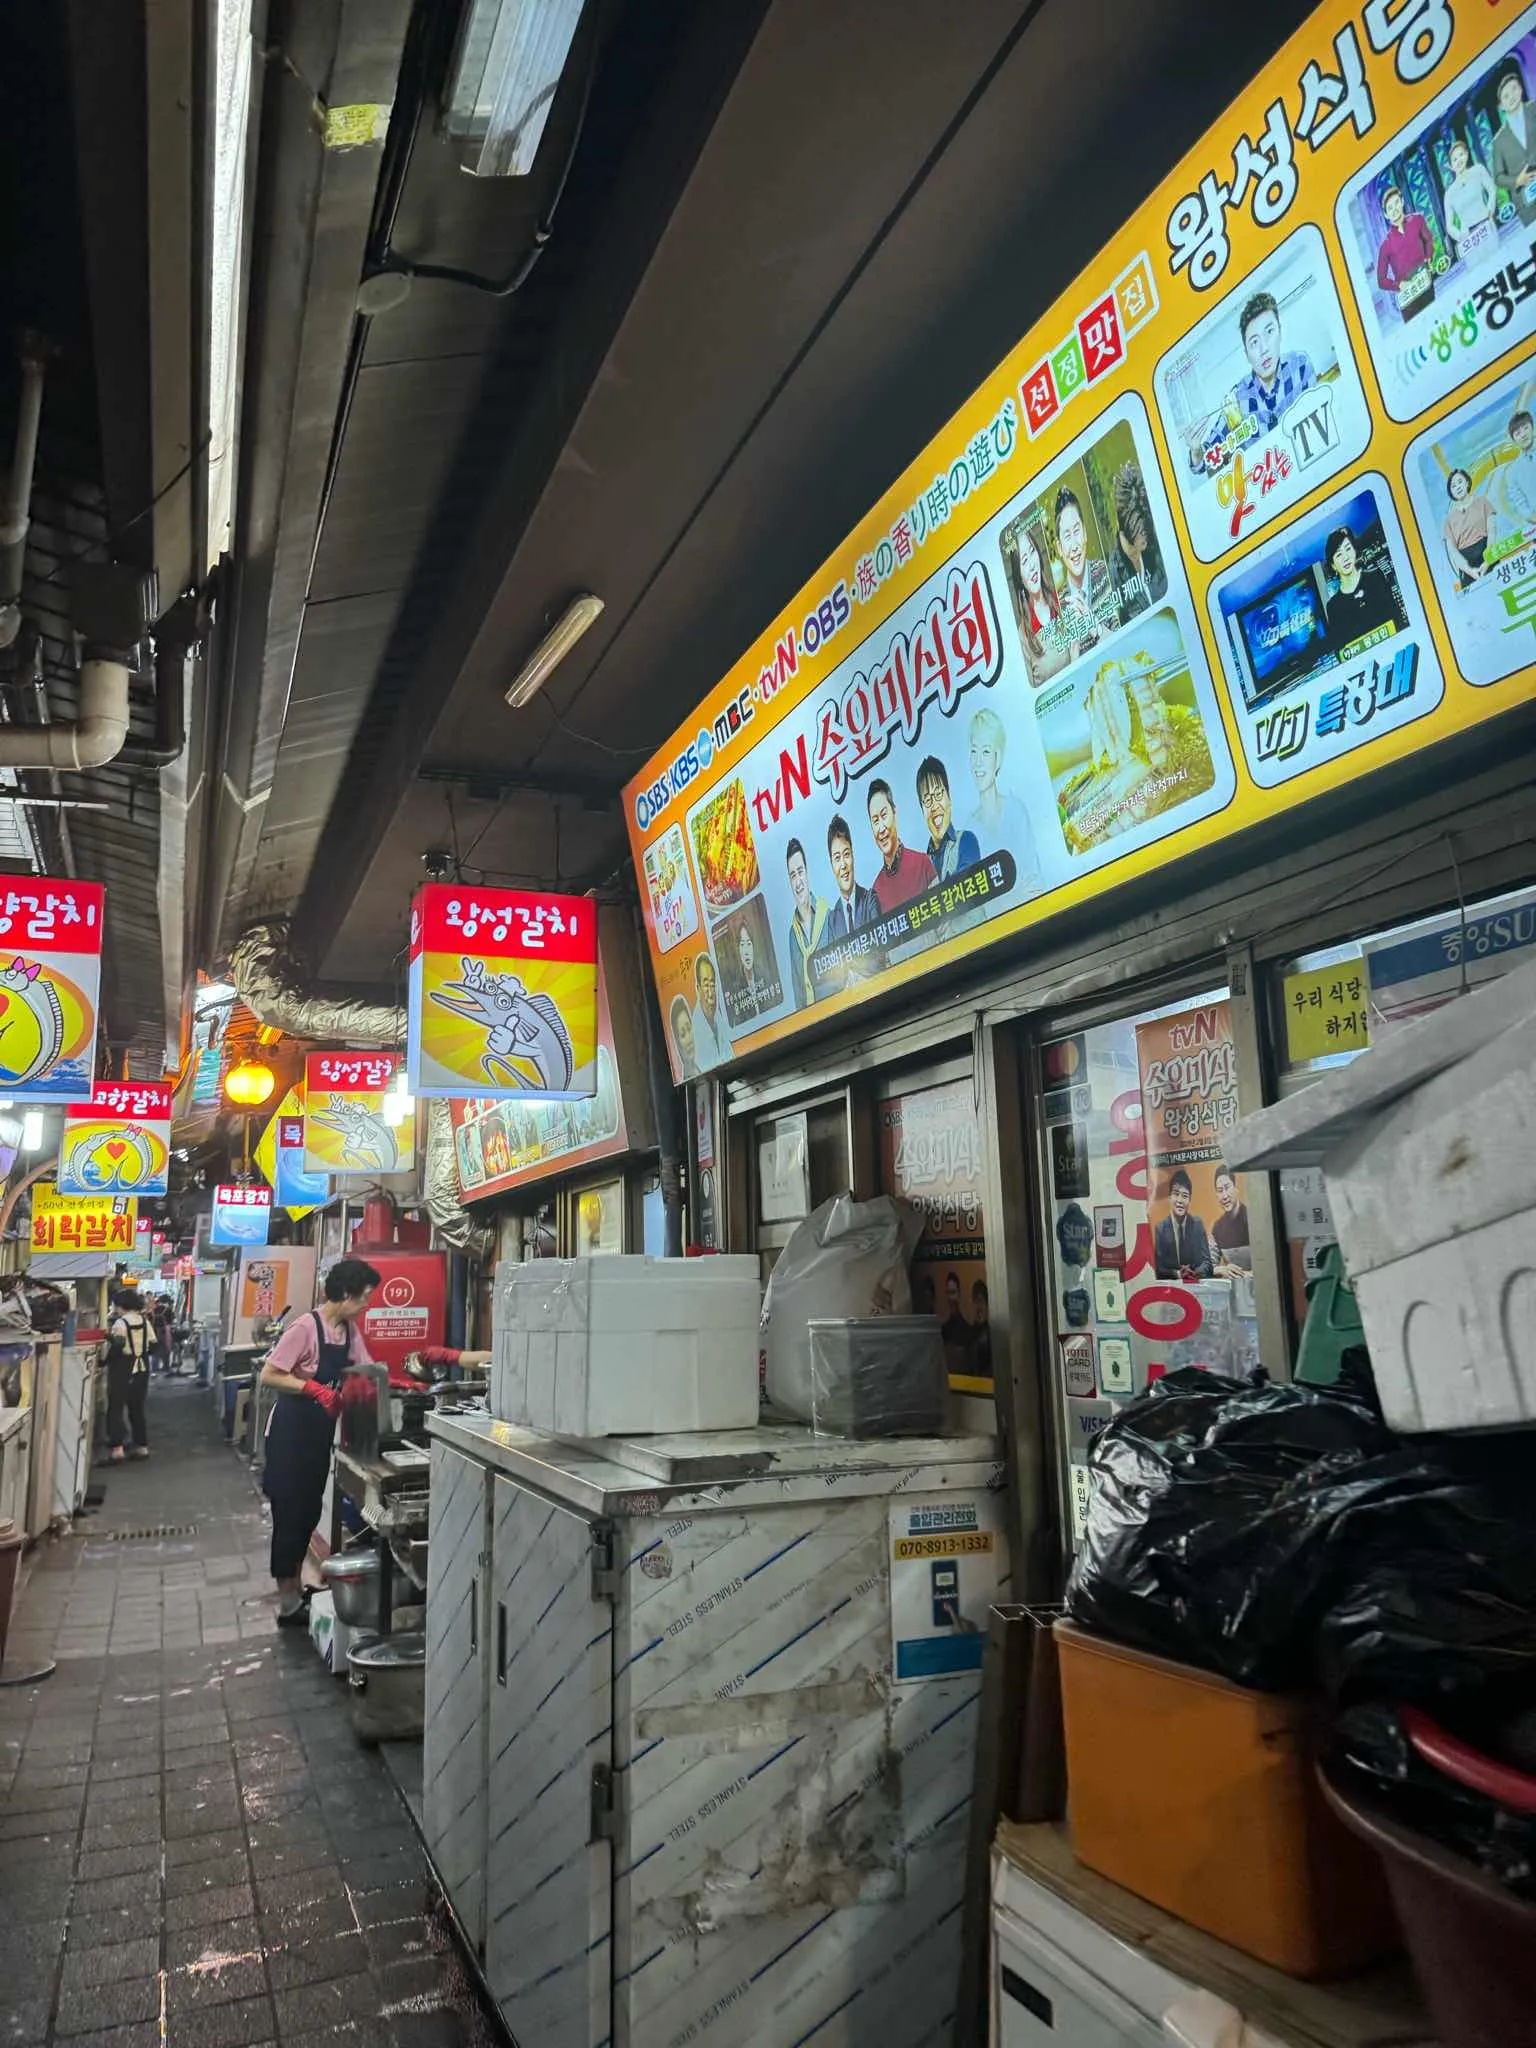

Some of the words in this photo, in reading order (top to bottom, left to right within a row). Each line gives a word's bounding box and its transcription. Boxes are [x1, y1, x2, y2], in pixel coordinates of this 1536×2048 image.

[1167, 0, 1455, 291] 왕성식당
[1029, 275, 1146, 418] 선정맛집
[1292, 401, 1329, 462] TV
[670, 746, 700, 793] KBS
[714, 686, 754, 746] MBC
[759, 632, 798, 702] tvN
[803, 583, 850, 653] OBS
[752, 735, 811, 833] tvN
[815, 568, 998, 796] 수요미식회
[1256, 701, 1310, 761] VJ
[1315, 643, 1420, 737] 특공대
[446, 900, 577, 947] 왕성갈치
[844, 925, 887, 969] 남대문시장
[887, 913, 908, 940] 대표
[908, 895, 942, 931] 밥도둑
[941, 871, 990, 913] 갈치조림
[988, 861, 1005, 887] 편
[1294, 985, 1323, 1015] 우리
[1327, 976, 1363, 1005] 식당
[1169, 1008, 1218, 1052] tvN
[1144, 1041, 1237, 1108] 수요미식
[94, 1089, 168, 1115] 고향갈치
[1163, 1097, 1238, 1138] 왕성식당
[284, 1124, 303, 1144] 목
[894, 1122, 981, 1192] 수요미식
[695, 1576, 743, 1617] STAINLESS
[666, 1613, 694, 1637] STEEL
[698, 1776, 748, 1819] STAINLESS
[669, 1815, 696, 1841] STEEL
